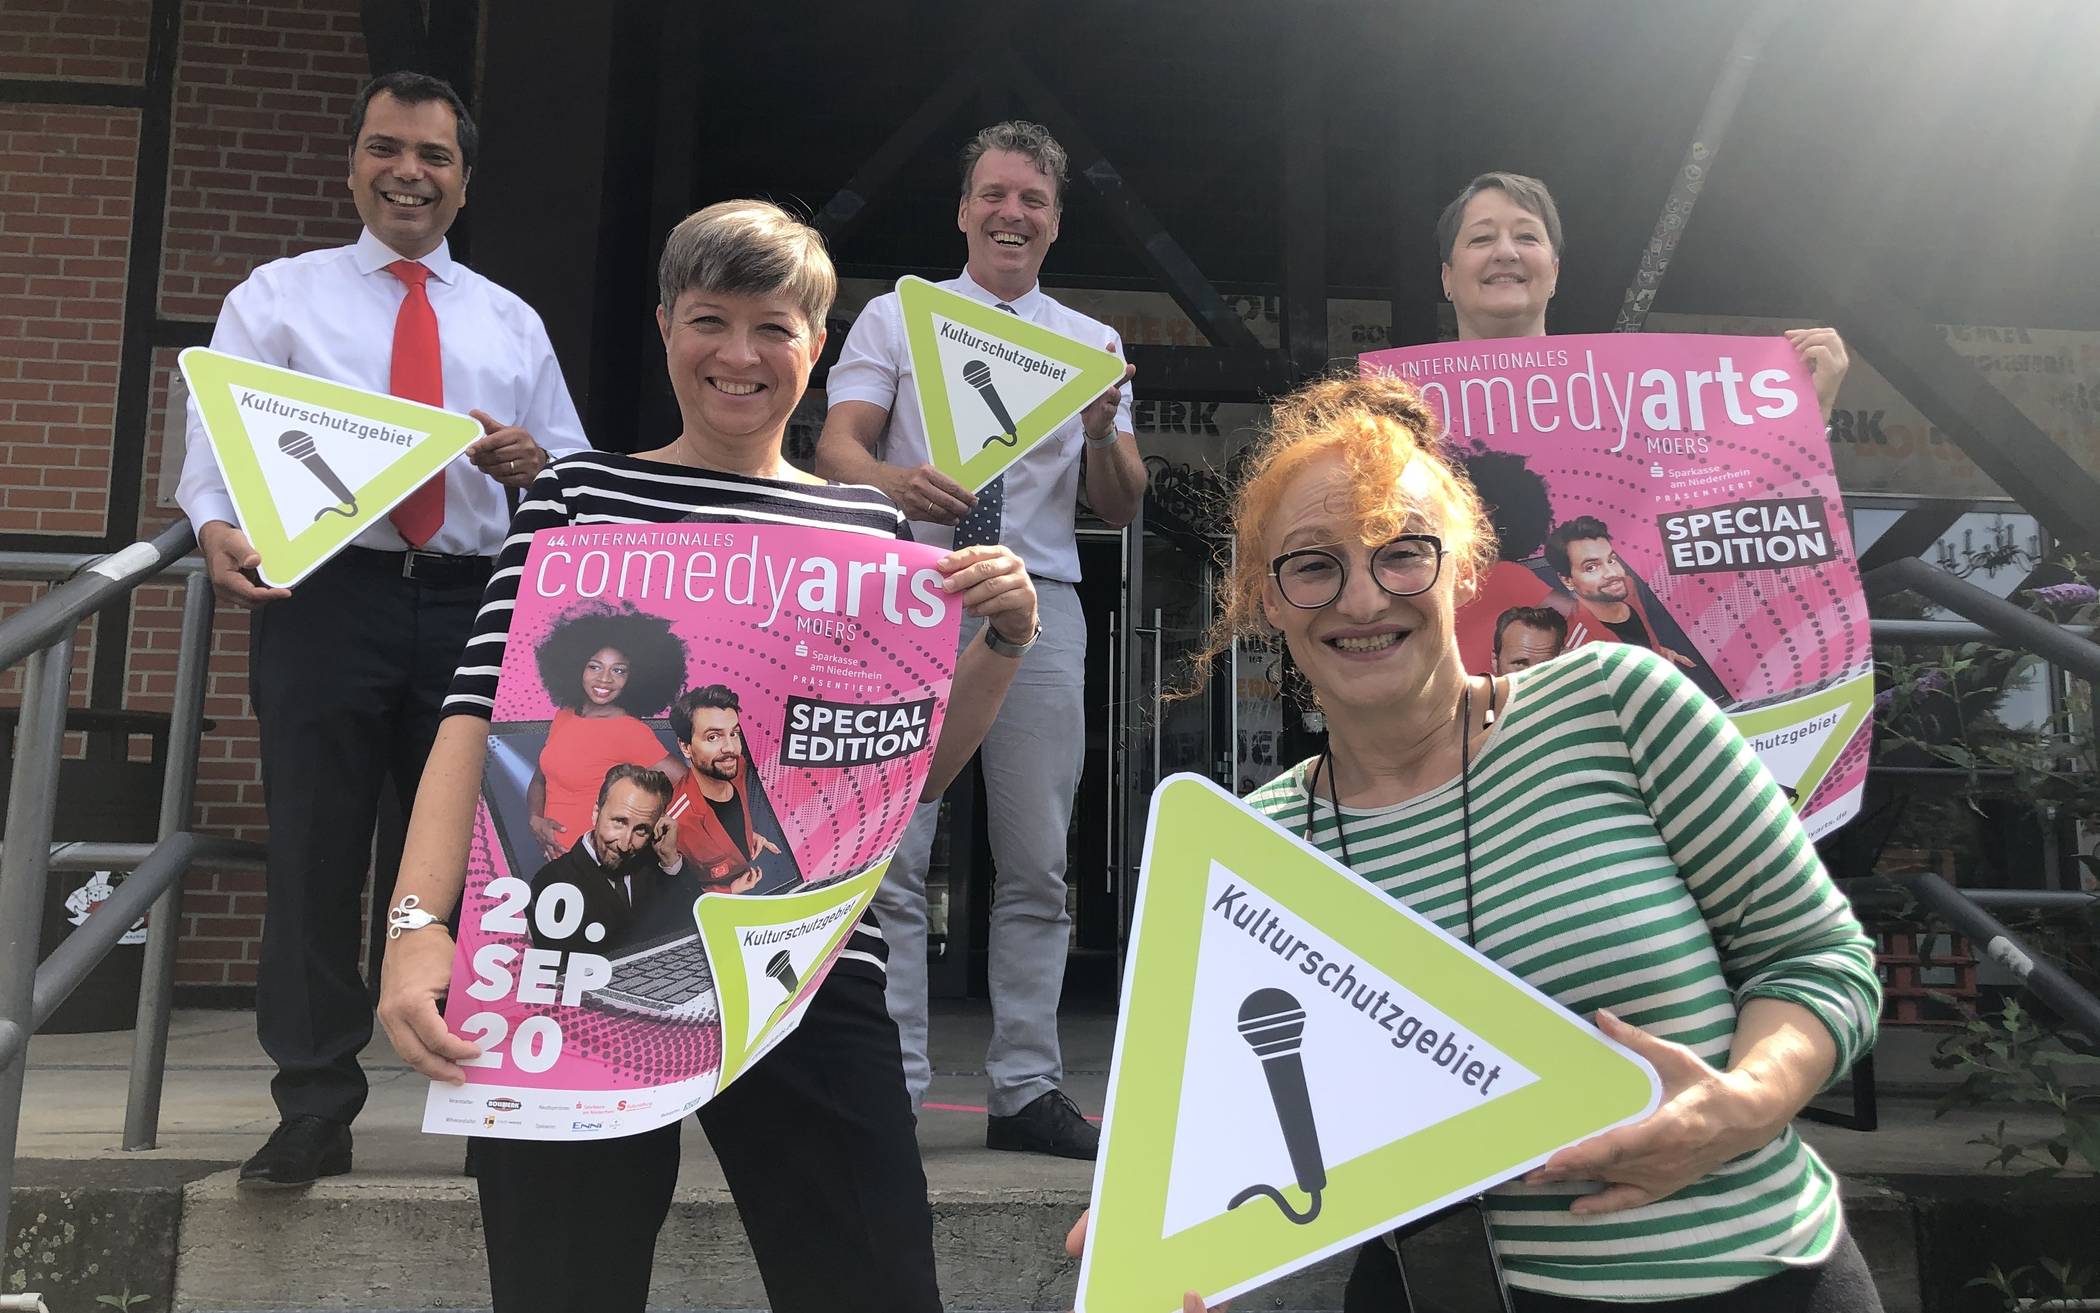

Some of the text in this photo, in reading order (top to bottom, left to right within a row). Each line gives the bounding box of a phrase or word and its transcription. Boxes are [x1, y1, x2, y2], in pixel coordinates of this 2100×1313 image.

[940, 321, 1067, 382] Kulturschutzgebiet
[1402, 350, 1568, 379] INTERNATIONALES
[240, 391, 414, 448] Kulturschutzgebiet
[1418, 349, 1799, 454] omedyarts
[1646, 437, 1709, 455] MOERS
[1668, 464, 1720, 479] Sparkasse
[1670, 469, 1751, 489] am Niederrhein
[1655, 481, 1754, 502] PRÄSENTIERT
[546, 533, 735, 548] 44. INTERNATIONALES
[1665, 504, 1821, 541] SPECIAL
[1671, 532, 1828, 568] EDITION
[536, 534, 947, 629] comedyarts
[796, 615, 857, 641] MOERS
[810, 663, 883, 680] am Niederrhein
[811, 650, 859, 667] Sparkasse
[792, 674, 882, 693] PRÄSENTIERT
[790, 703, 927, 735] SPECIAL
[1750, 713, 1838, 753] hutzgebiet
[787, 726, 926, 762] EDITION
[479, 876, 606, 943] 20.
[743, 899, 857, 947] Kulturschutzgebiet
[465, 943, 613, 1008] SEP
[1211, 883, 1502, 1097] Kulturschutzgebiet
[455, 1011, 564, 1074] 20
